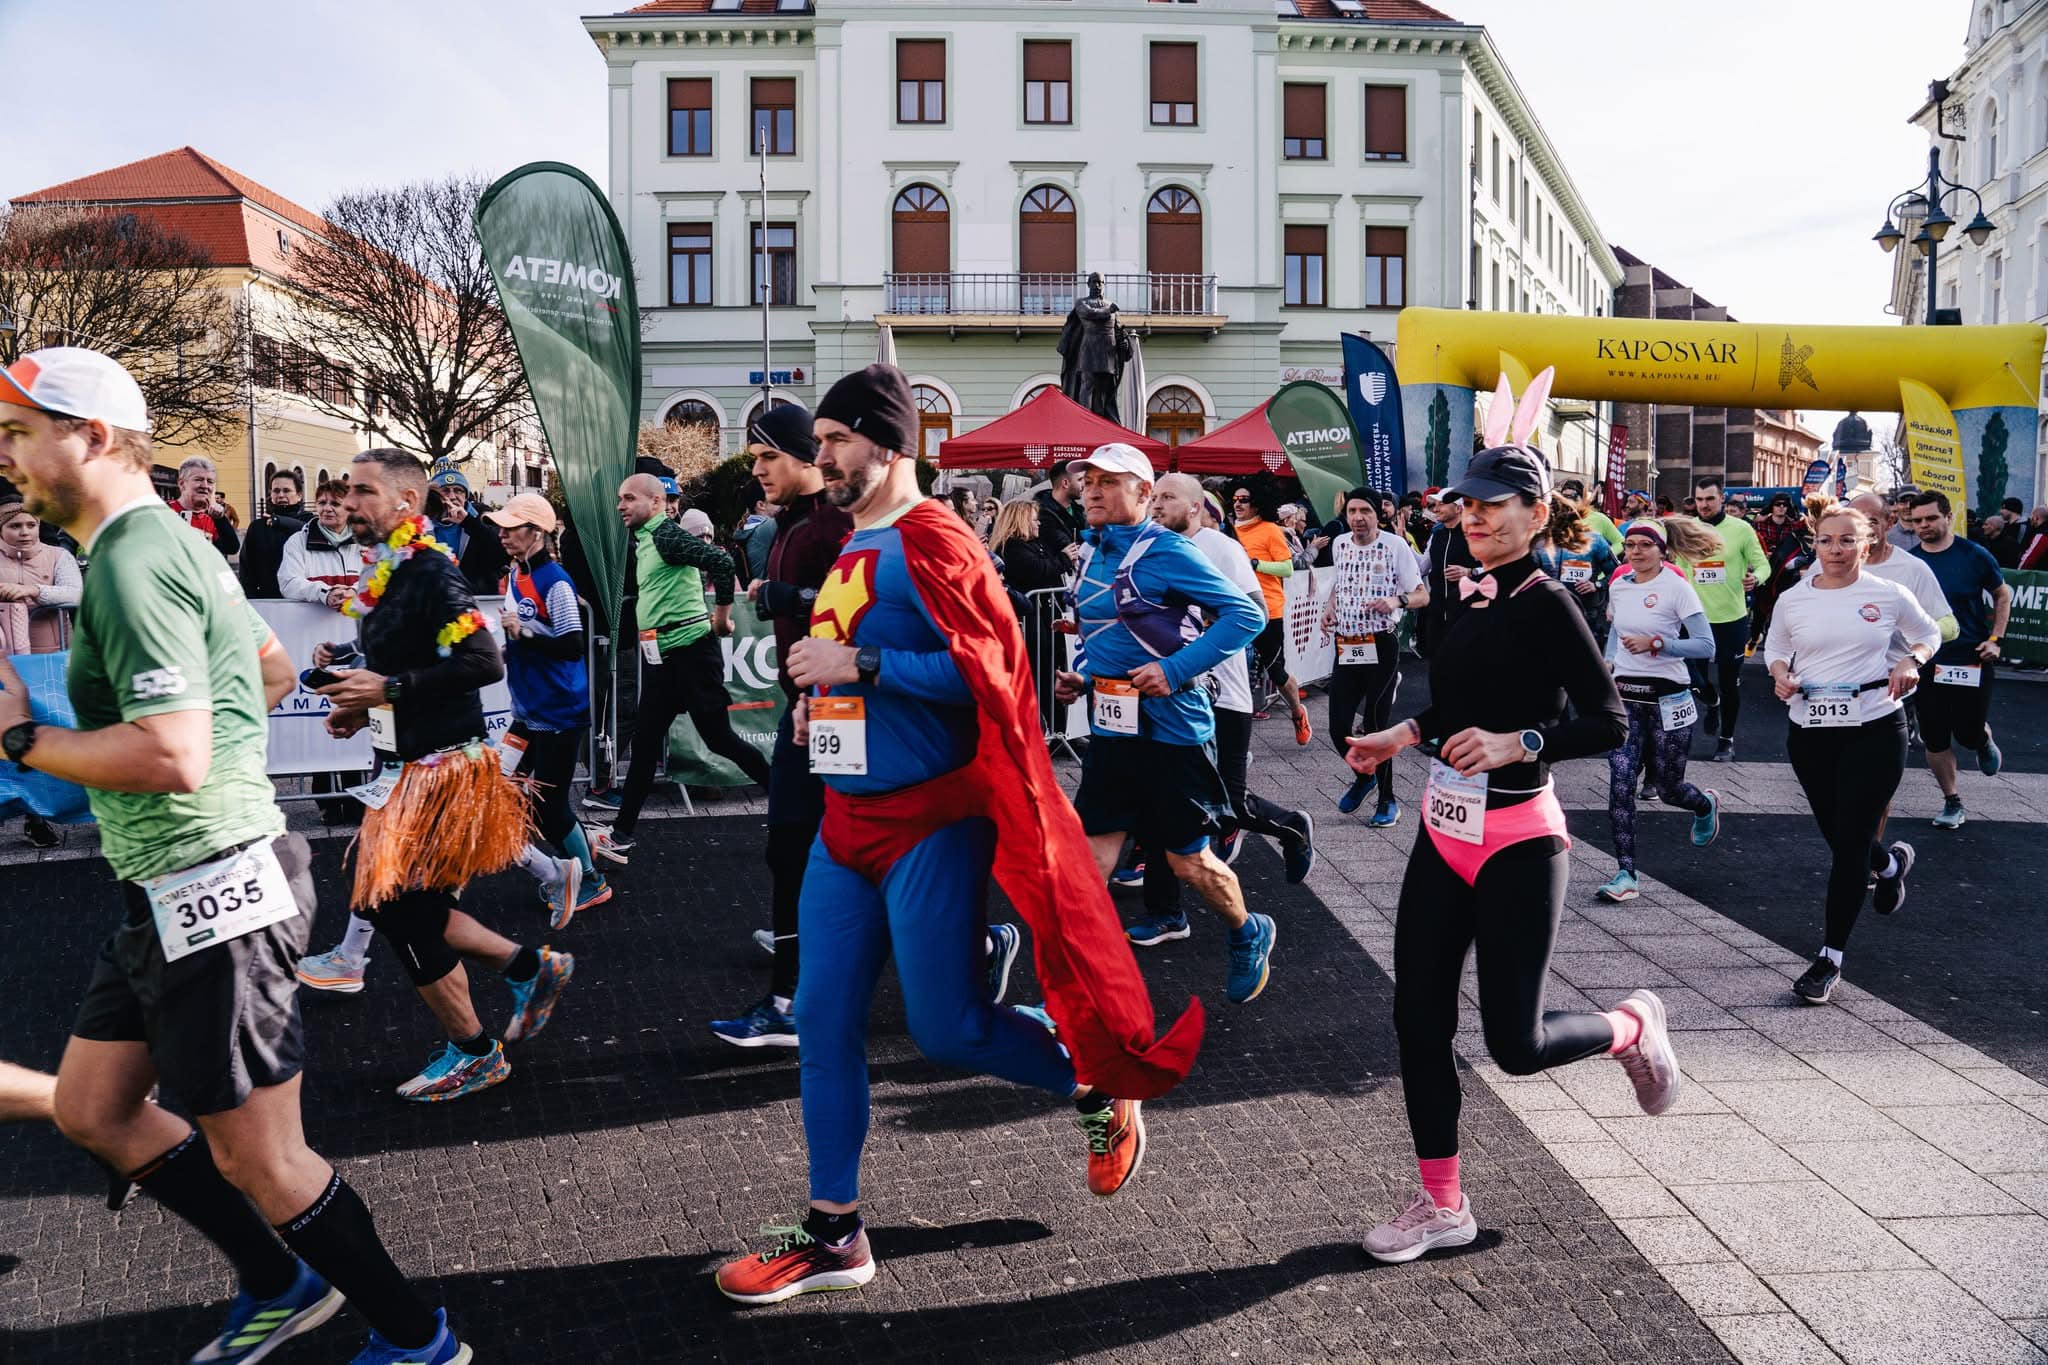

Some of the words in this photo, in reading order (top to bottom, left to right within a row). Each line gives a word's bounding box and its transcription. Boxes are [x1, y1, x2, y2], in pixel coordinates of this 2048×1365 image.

[1596, 338, 1738, 364] KAPOSVÁR
[1608, 369, 1721, 381] WWW.KAPOSVAR.HU
[1352, 649, 1364, 657] 86
[1947, 671, 1969, 679] 115
[1101, 703, 1122, 719] 116
[1809, 704, 1849, 717] 3013
[812, 735, 840, 754] 199
[1430, 795, 1467, 824] 3020
[176, 879, 263, 929] 3035
